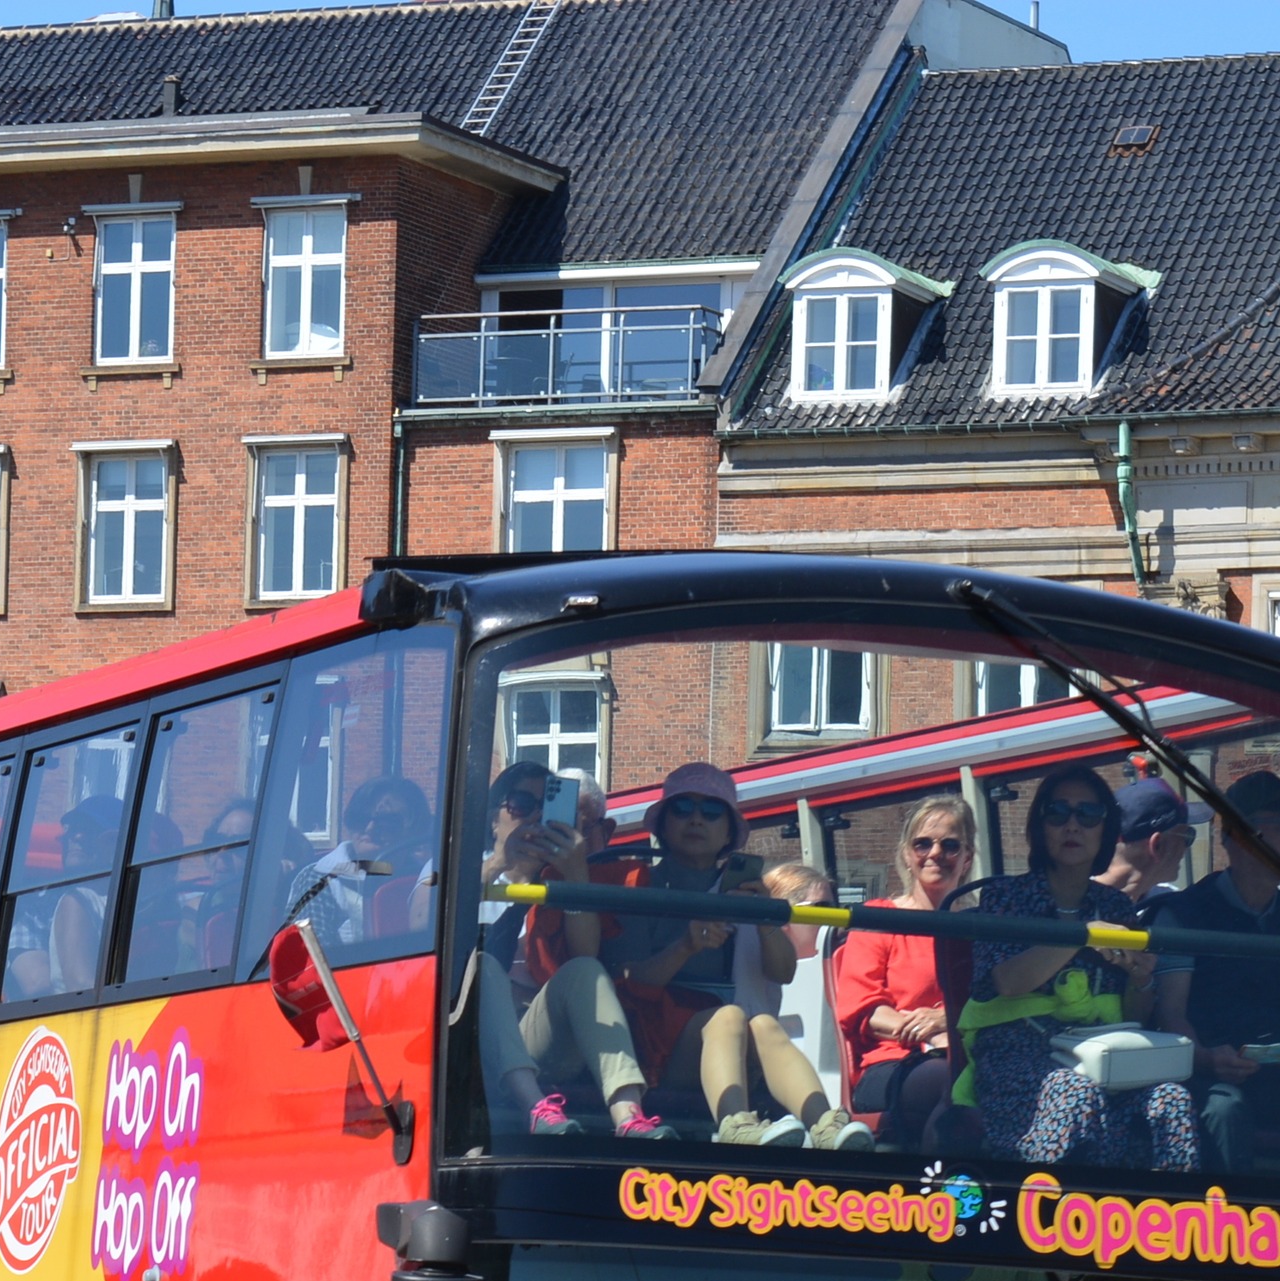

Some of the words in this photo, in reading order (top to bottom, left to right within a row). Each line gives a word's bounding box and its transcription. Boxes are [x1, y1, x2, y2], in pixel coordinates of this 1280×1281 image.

[11, 1070, 27, 1120] CITY
[27, 1043, 69, 1094] SIGHTSEEING
[103, 1050, 158, 1151] Hop
[163, 1039, 201, 1138] On
[20, 1179, 57, 1242] TOUR
[94, 1177, 144, 1276] Hop
[150, 1169, 196, 1264] Off
[619, 1167, 957, 1243] CitySightseeing
